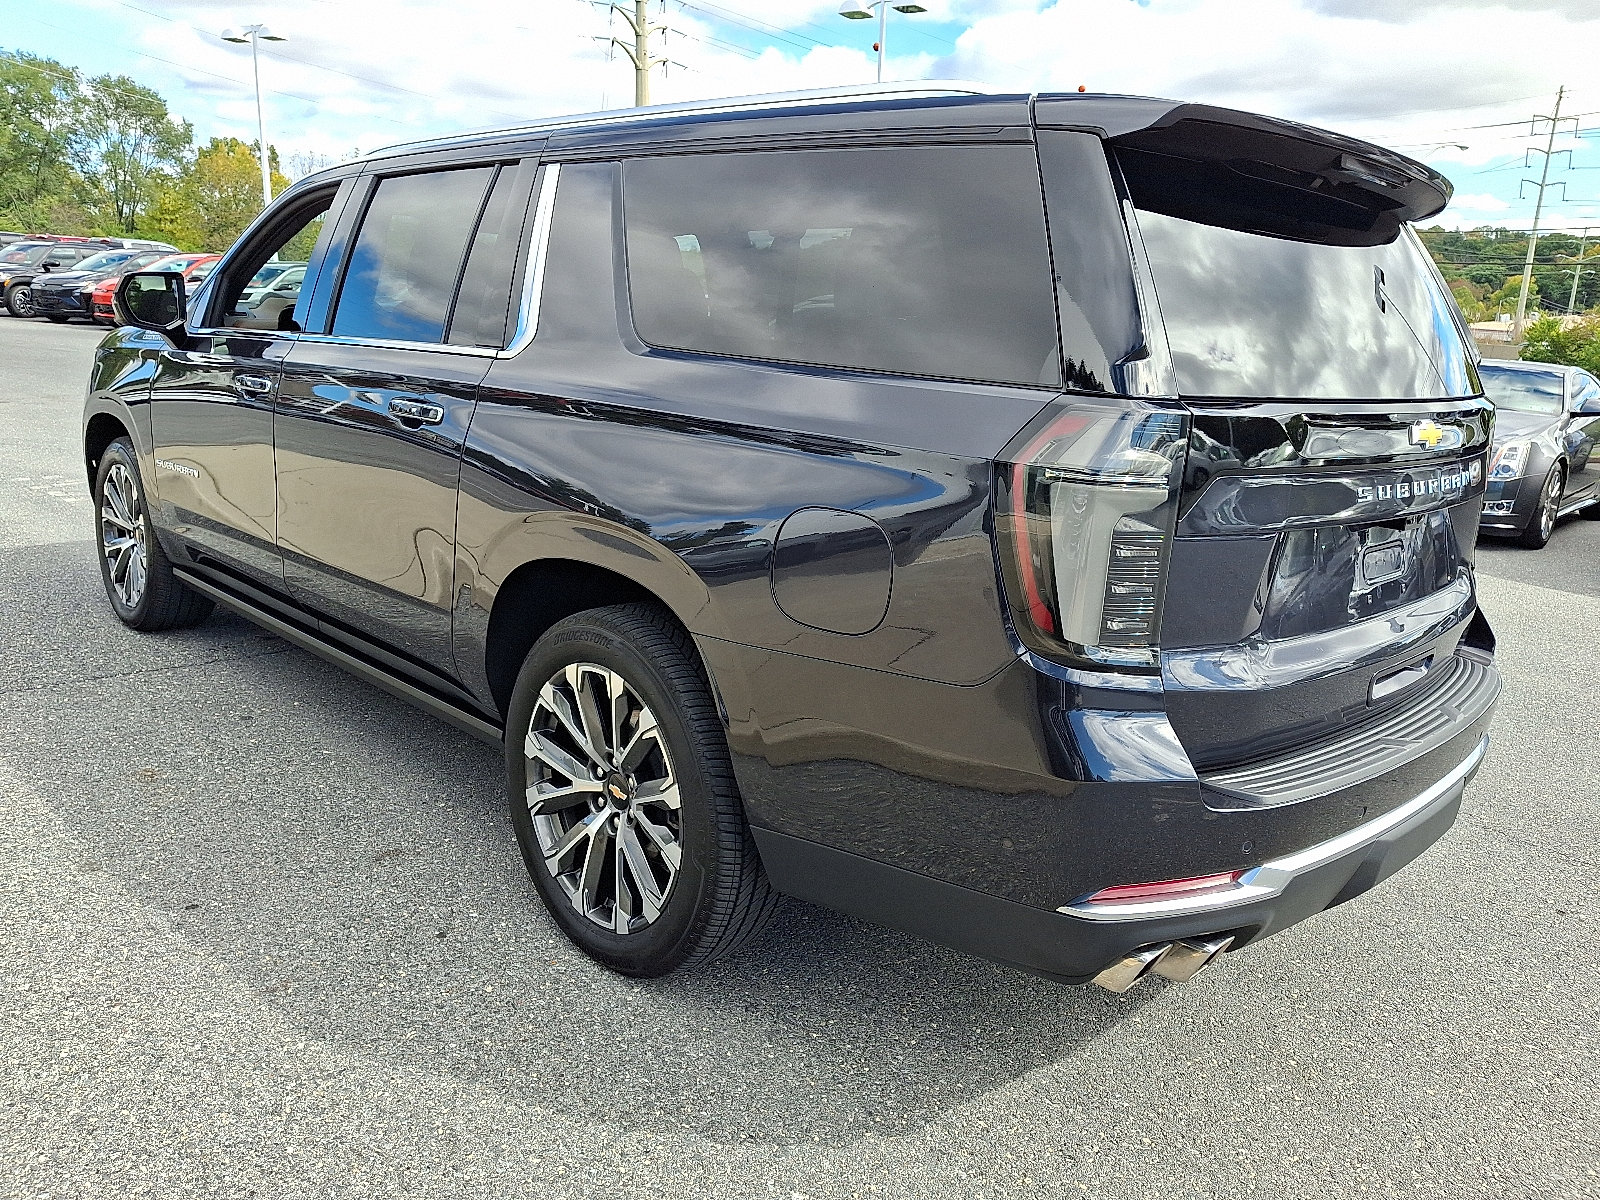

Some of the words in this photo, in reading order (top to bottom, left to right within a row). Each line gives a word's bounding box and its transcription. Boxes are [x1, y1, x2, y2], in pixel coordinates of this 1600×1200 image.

[156, 459, 200, 478] SUBURBAN
[1357, 470, 1470, 502] SUBURBAN
[553, 630, 614, 650] BRIDGESTONE
